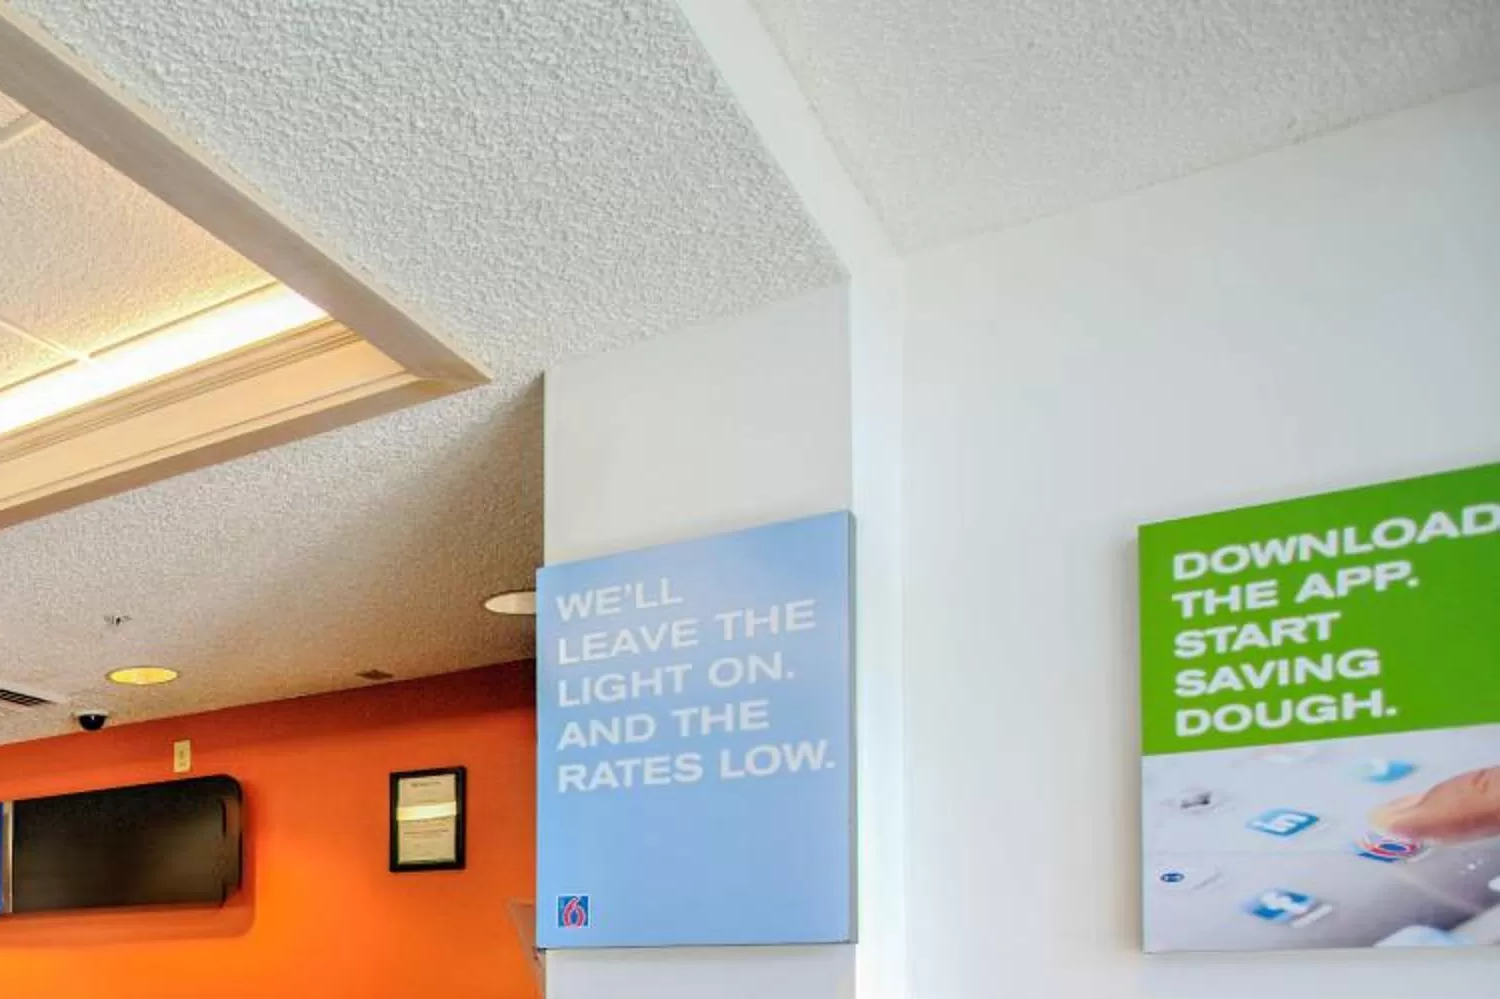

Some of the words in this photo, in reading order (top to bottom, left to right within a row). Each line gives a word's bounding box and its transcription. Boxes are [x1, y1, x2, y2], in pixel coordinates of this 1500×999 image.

[1172, 503, 1500, 581] DOWNLOAD
[1171, 579, 1279, 619] THE
[1293, 560, 1419, 603] APP.
[557, 618, 699, 665] LEAVE
[715, 598, 816, 641] THE
[1174, 611, 1341, 659] START
[557, 664, 693, 707] LIGHT
[708, 651, 794, 689] ON.
[1175, 648, 1381, 697] SAVING
[557, 713, 656, 752] AND
[671, 699, 770, 738] THE
[1175, 689, 1397, 738] DOUGH.
[558, 752, 703, 793] RATES
[720, 740, 836, 780] LOW.
